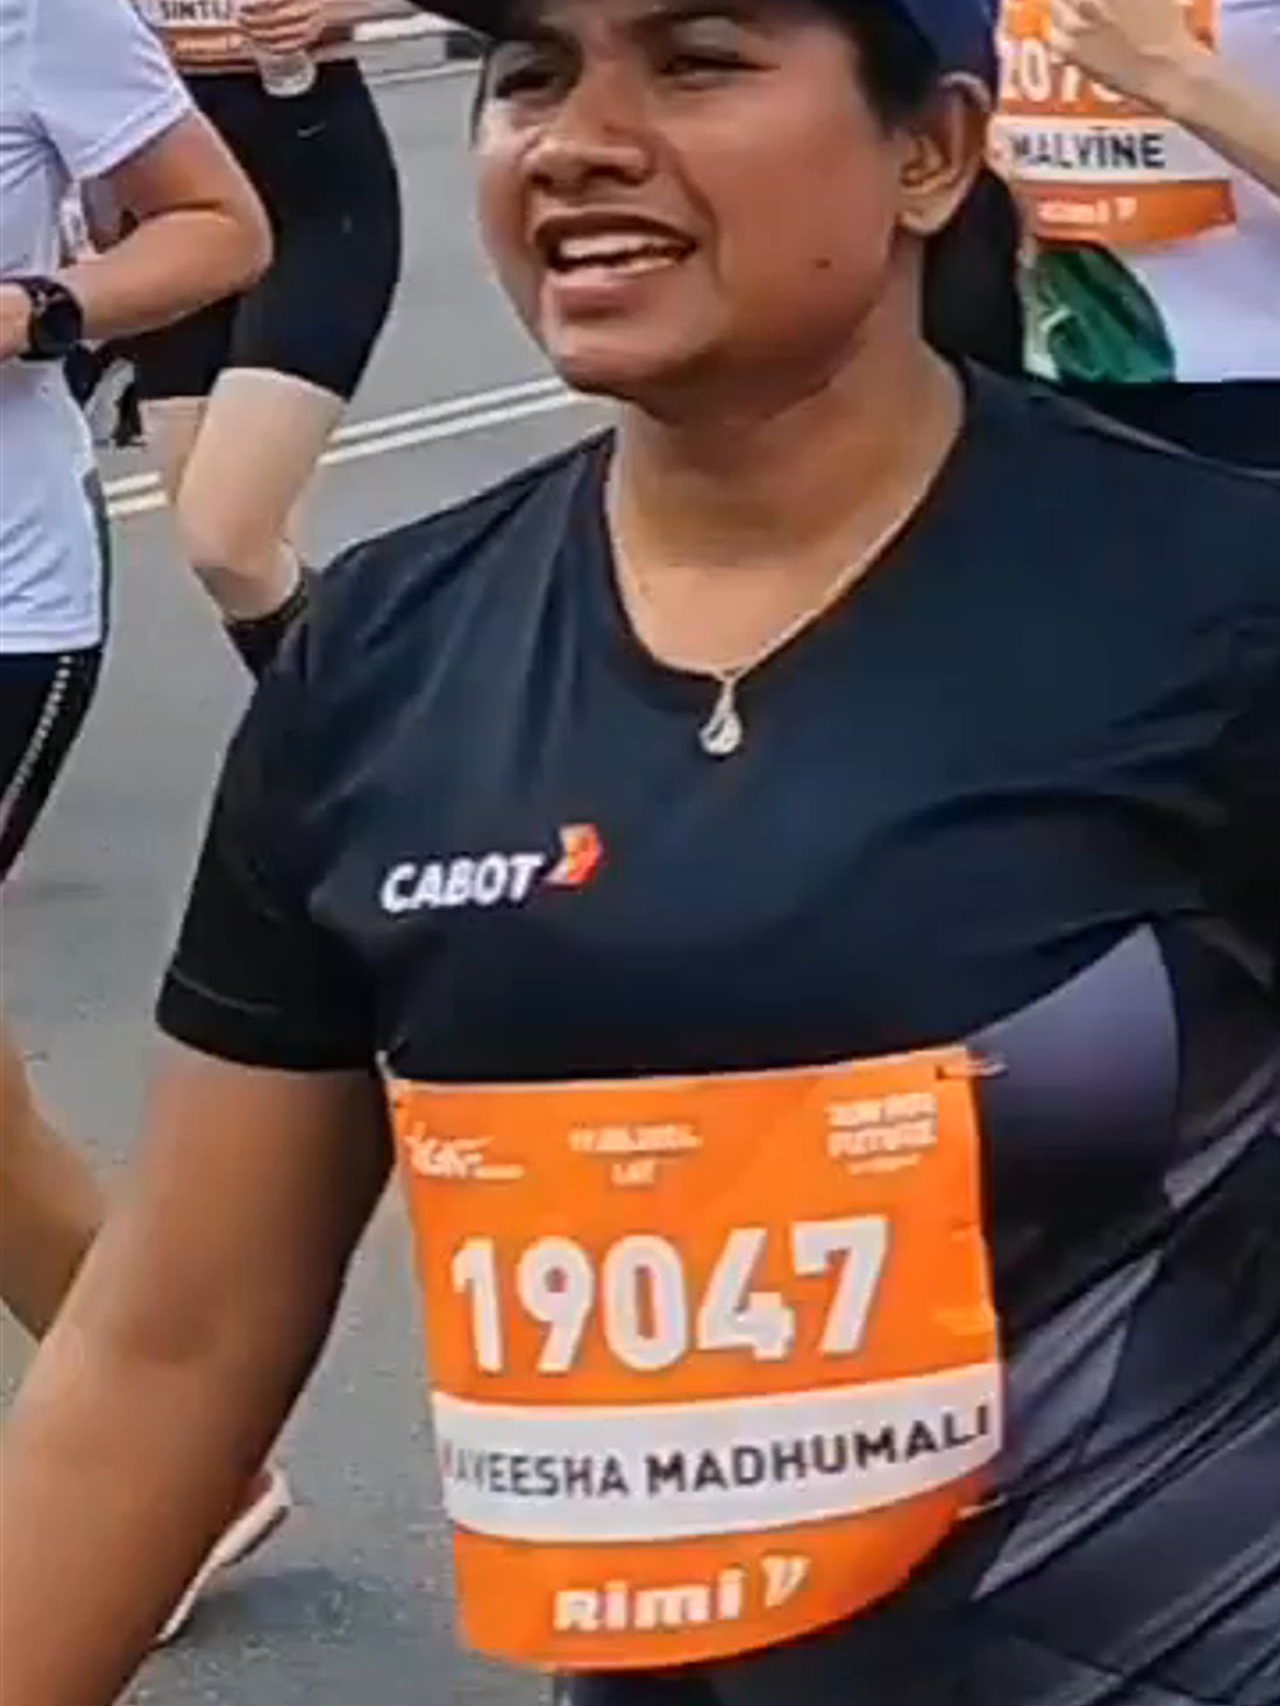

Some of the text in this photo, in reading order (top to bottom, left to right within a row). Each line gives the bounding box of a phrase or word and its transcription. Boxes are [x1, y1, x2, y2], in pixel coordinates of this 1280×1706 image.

[380, 852, 545, 912] CABOT
[451, 1216, 888, 1373] 19047
[645, 1404, 991, 1497] MADHUMALI
